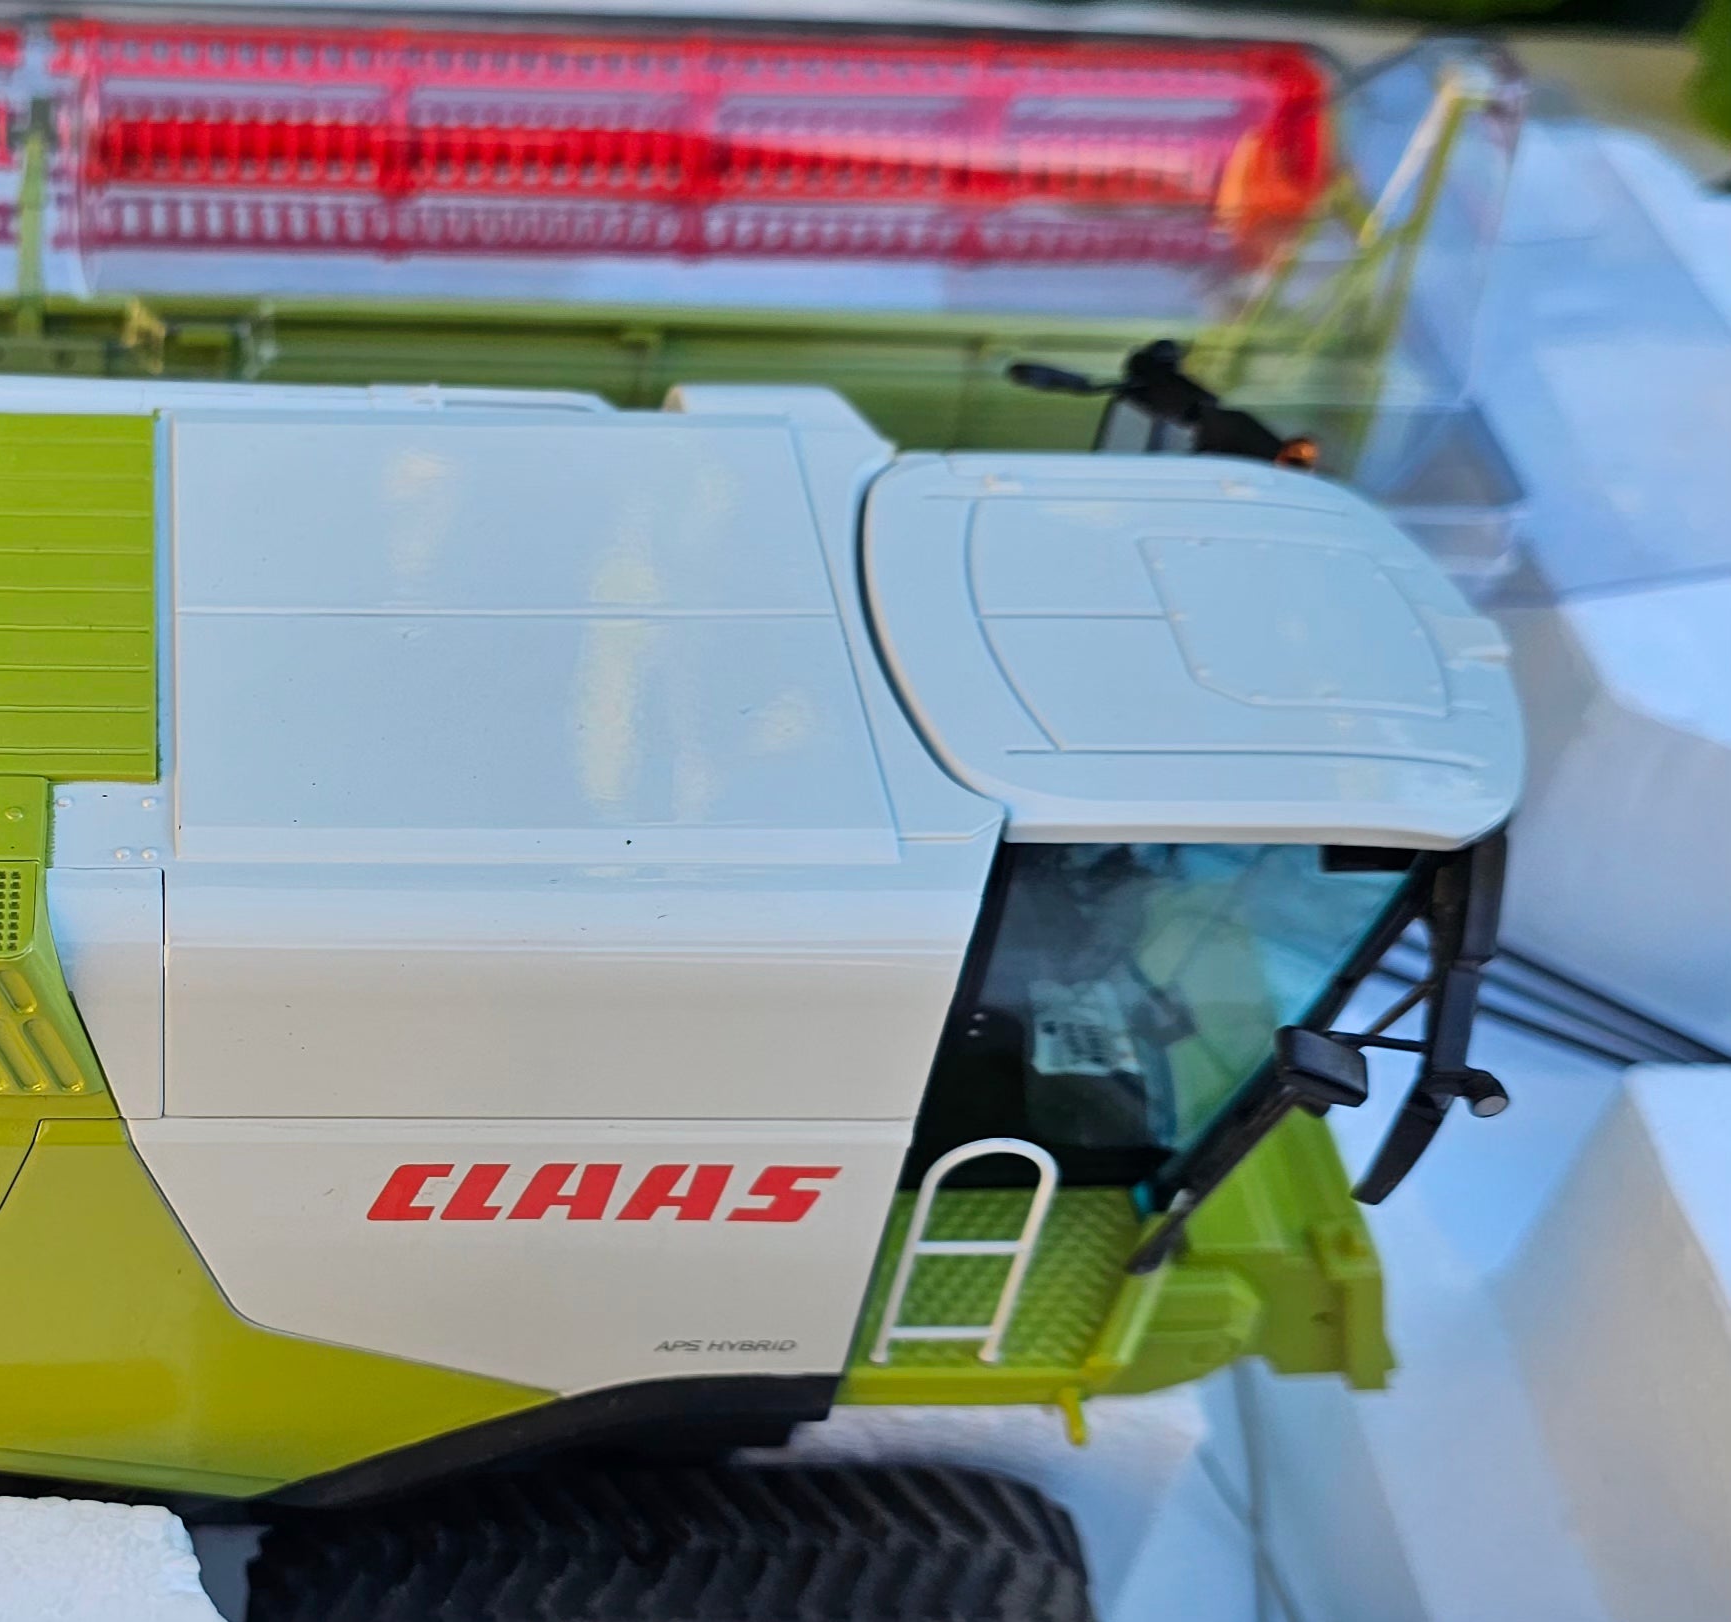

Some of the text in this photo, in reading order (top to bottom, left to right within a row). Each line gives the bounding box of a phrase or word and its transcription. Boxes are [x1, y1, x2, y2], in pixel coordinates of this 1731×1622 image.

[367, 1163, 842, 1222] CLAAS
[654, 1339, 797, 1352] APS HYBRID
